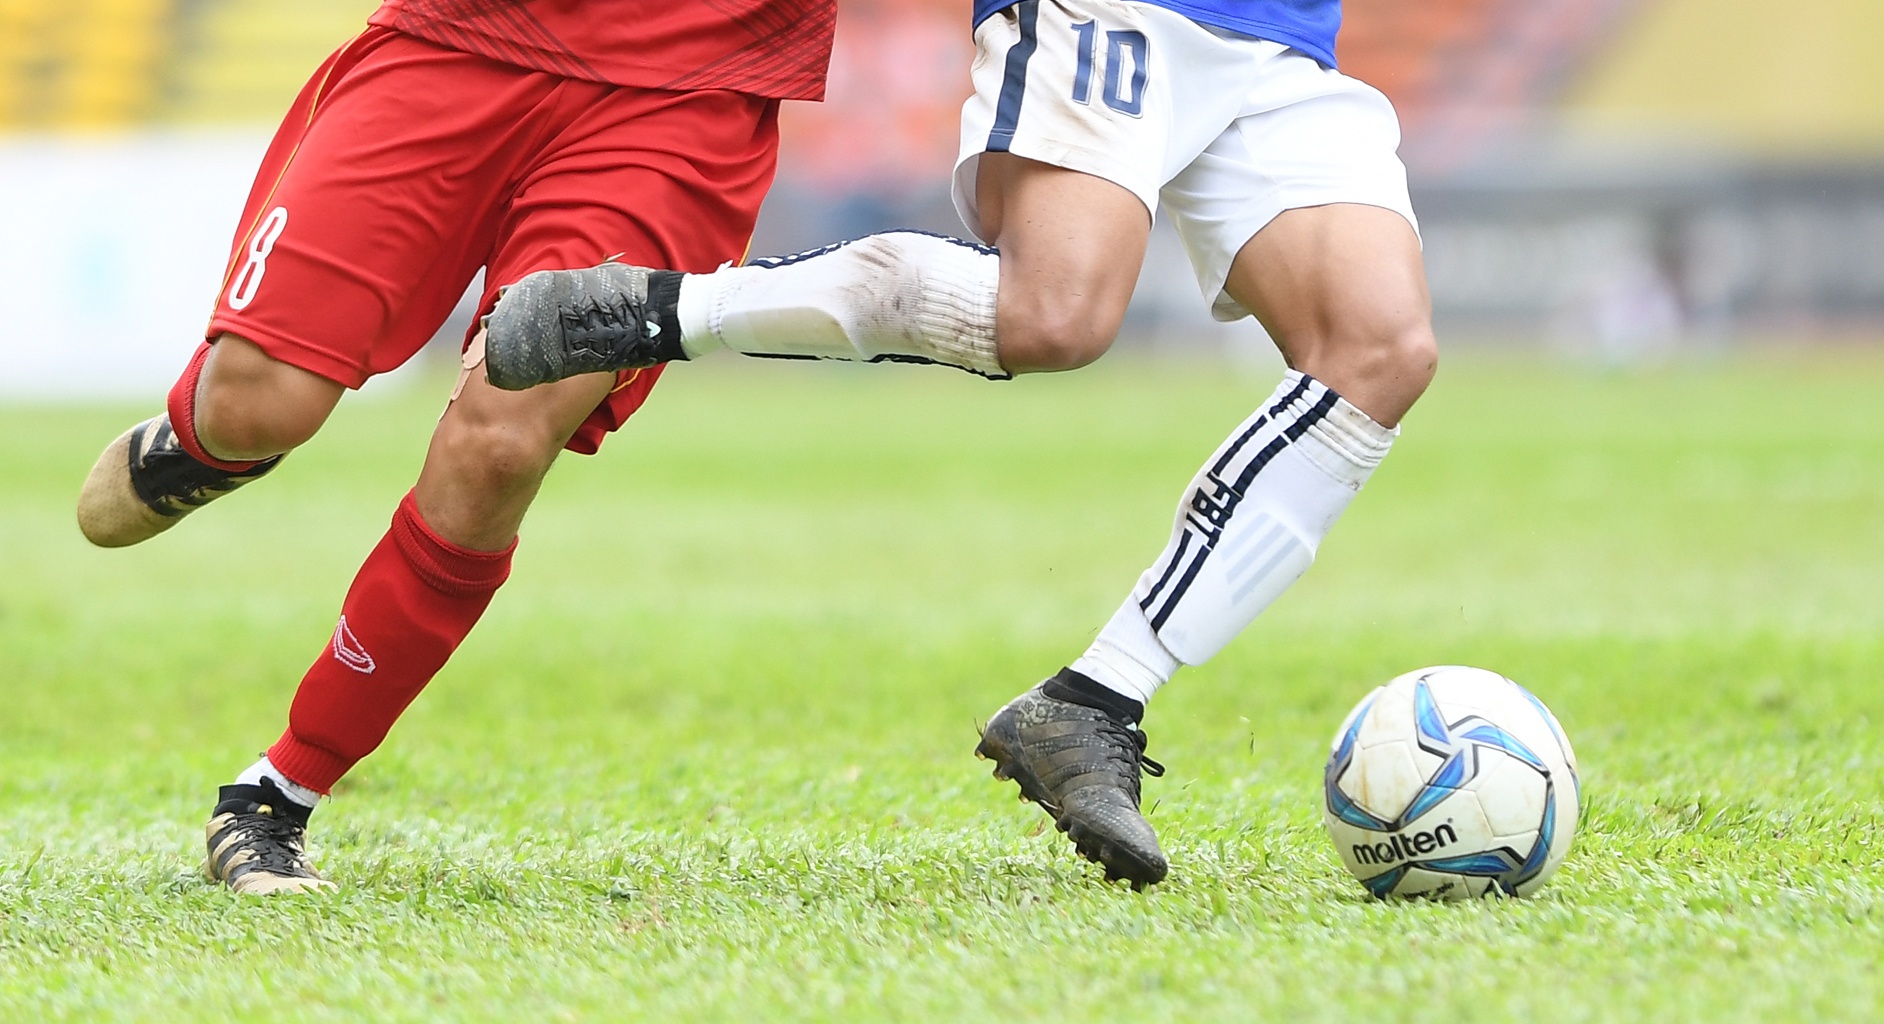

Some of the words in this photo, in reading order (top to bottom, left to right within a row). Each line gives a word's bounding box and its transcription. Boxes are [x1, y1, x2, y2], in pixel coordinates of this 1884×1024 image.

[1070, 18, 1150, 119] 10
[228, 205, 289, 311] 8
[1184, 470, 1245, 551] FBT
[1352, 820, 1459, 866] molten
